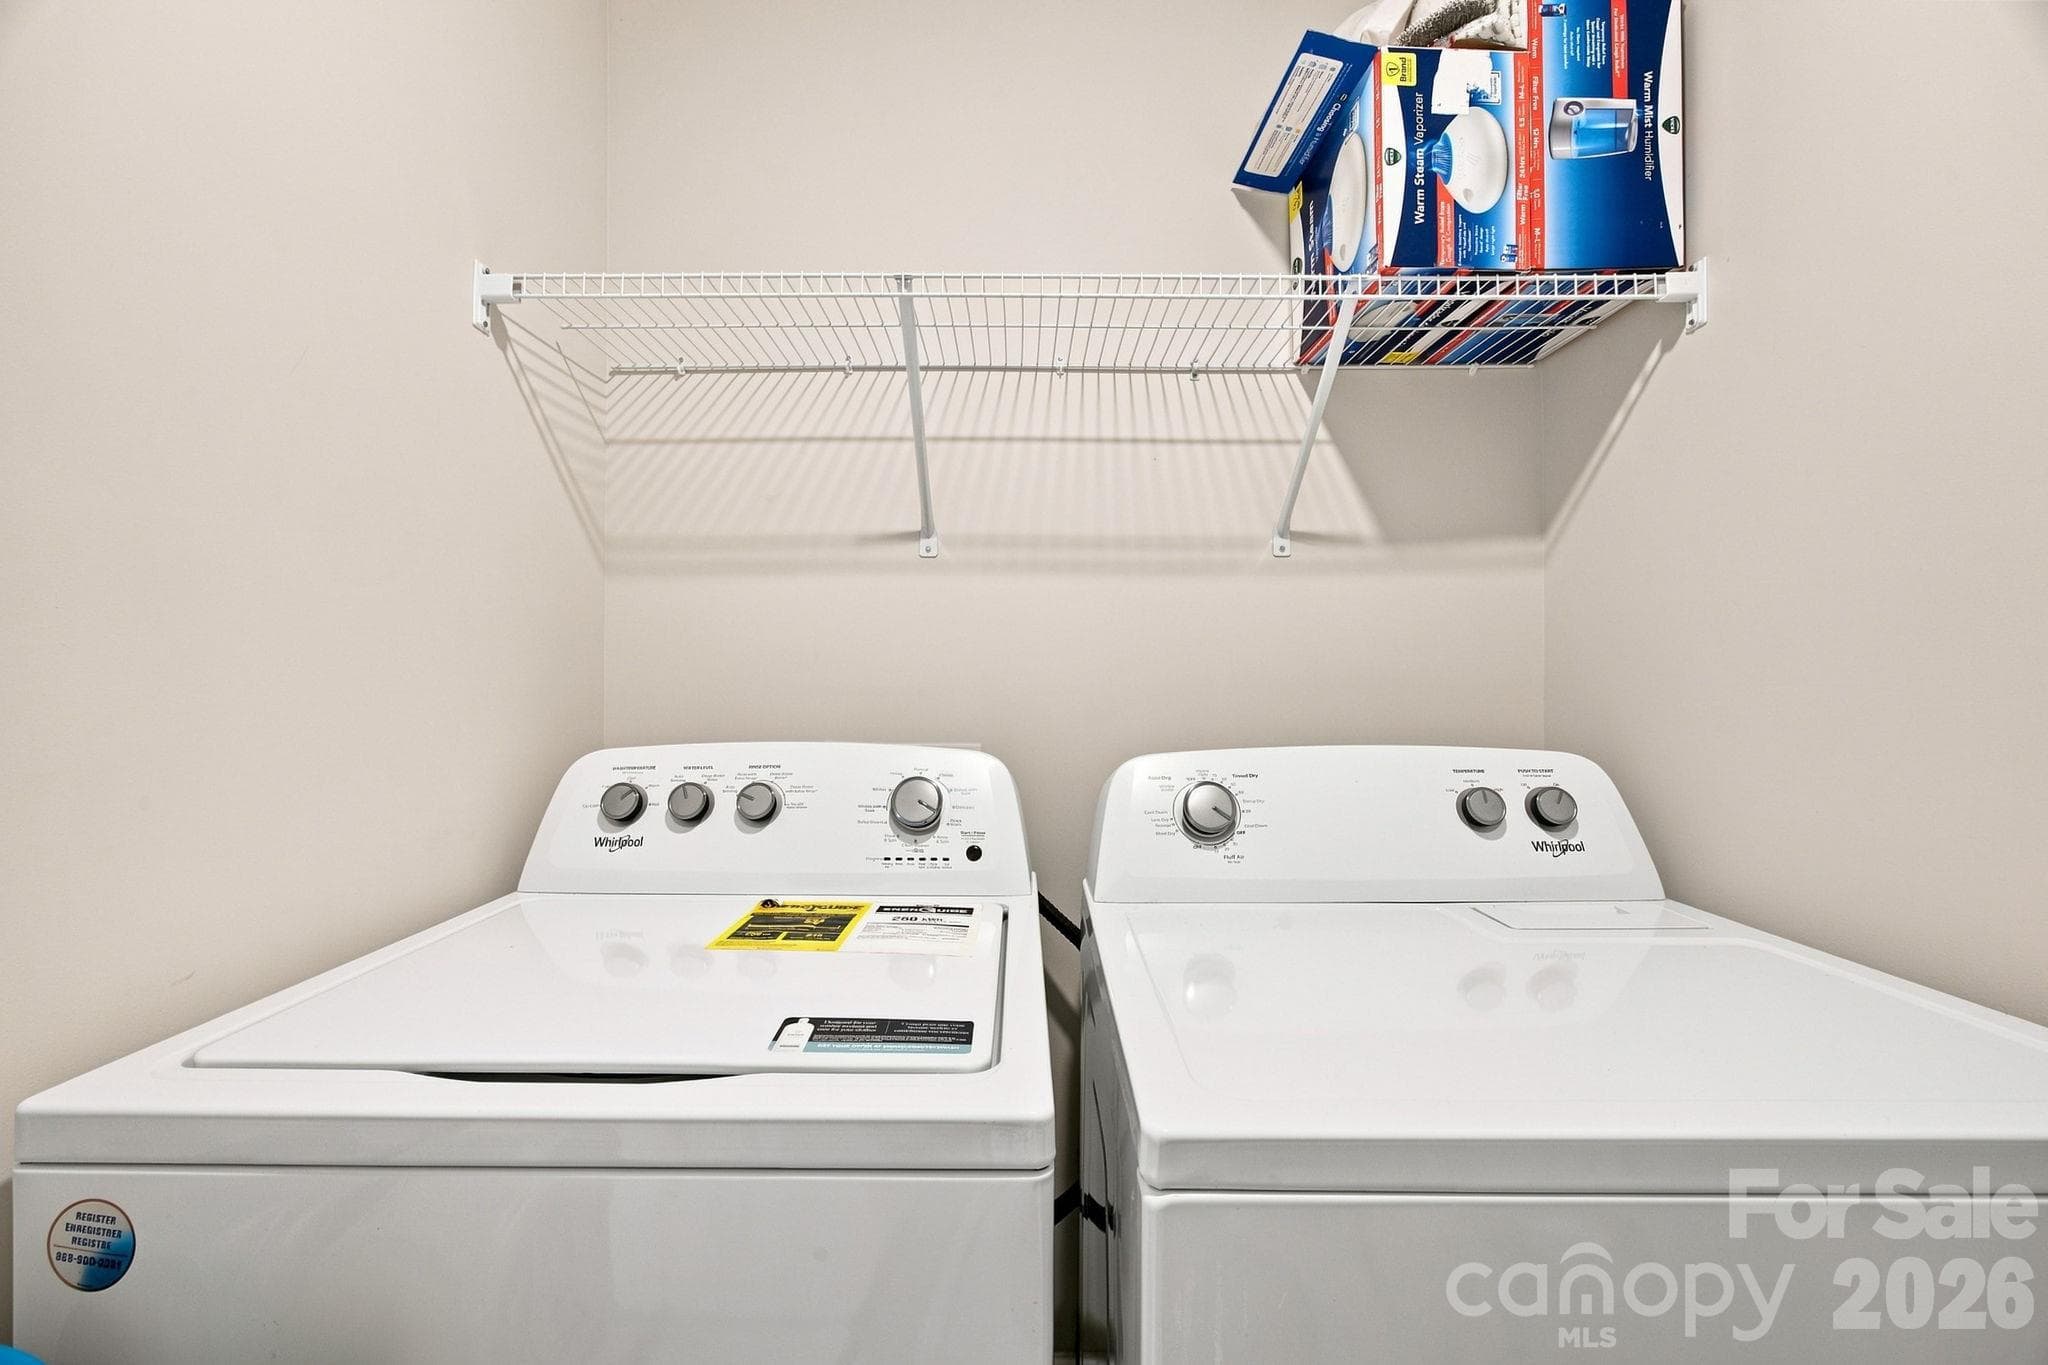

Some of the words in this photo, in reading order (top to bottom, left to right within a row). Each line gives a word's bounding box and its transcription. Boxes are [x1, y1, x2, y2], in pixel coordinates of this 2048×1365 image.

[1643, 71, 1653, 102] Warm
[1414, 92, 1427, 145] Vaporizer
[1643, 105, 1653, 128] Mist
[1414, 148, 1425, 186] Steam
[1644, 130, 1655, 181] Humidifier
[1414, 188, 1425, 224] Warm
[593, 834, 644, 853] Whirlpool
[1531, 838, 1586, 858] Whirlpool
[65, 1222, 123, 1240] ENREGISTRER
[75, 1211, 117, 1226] REGISTER
